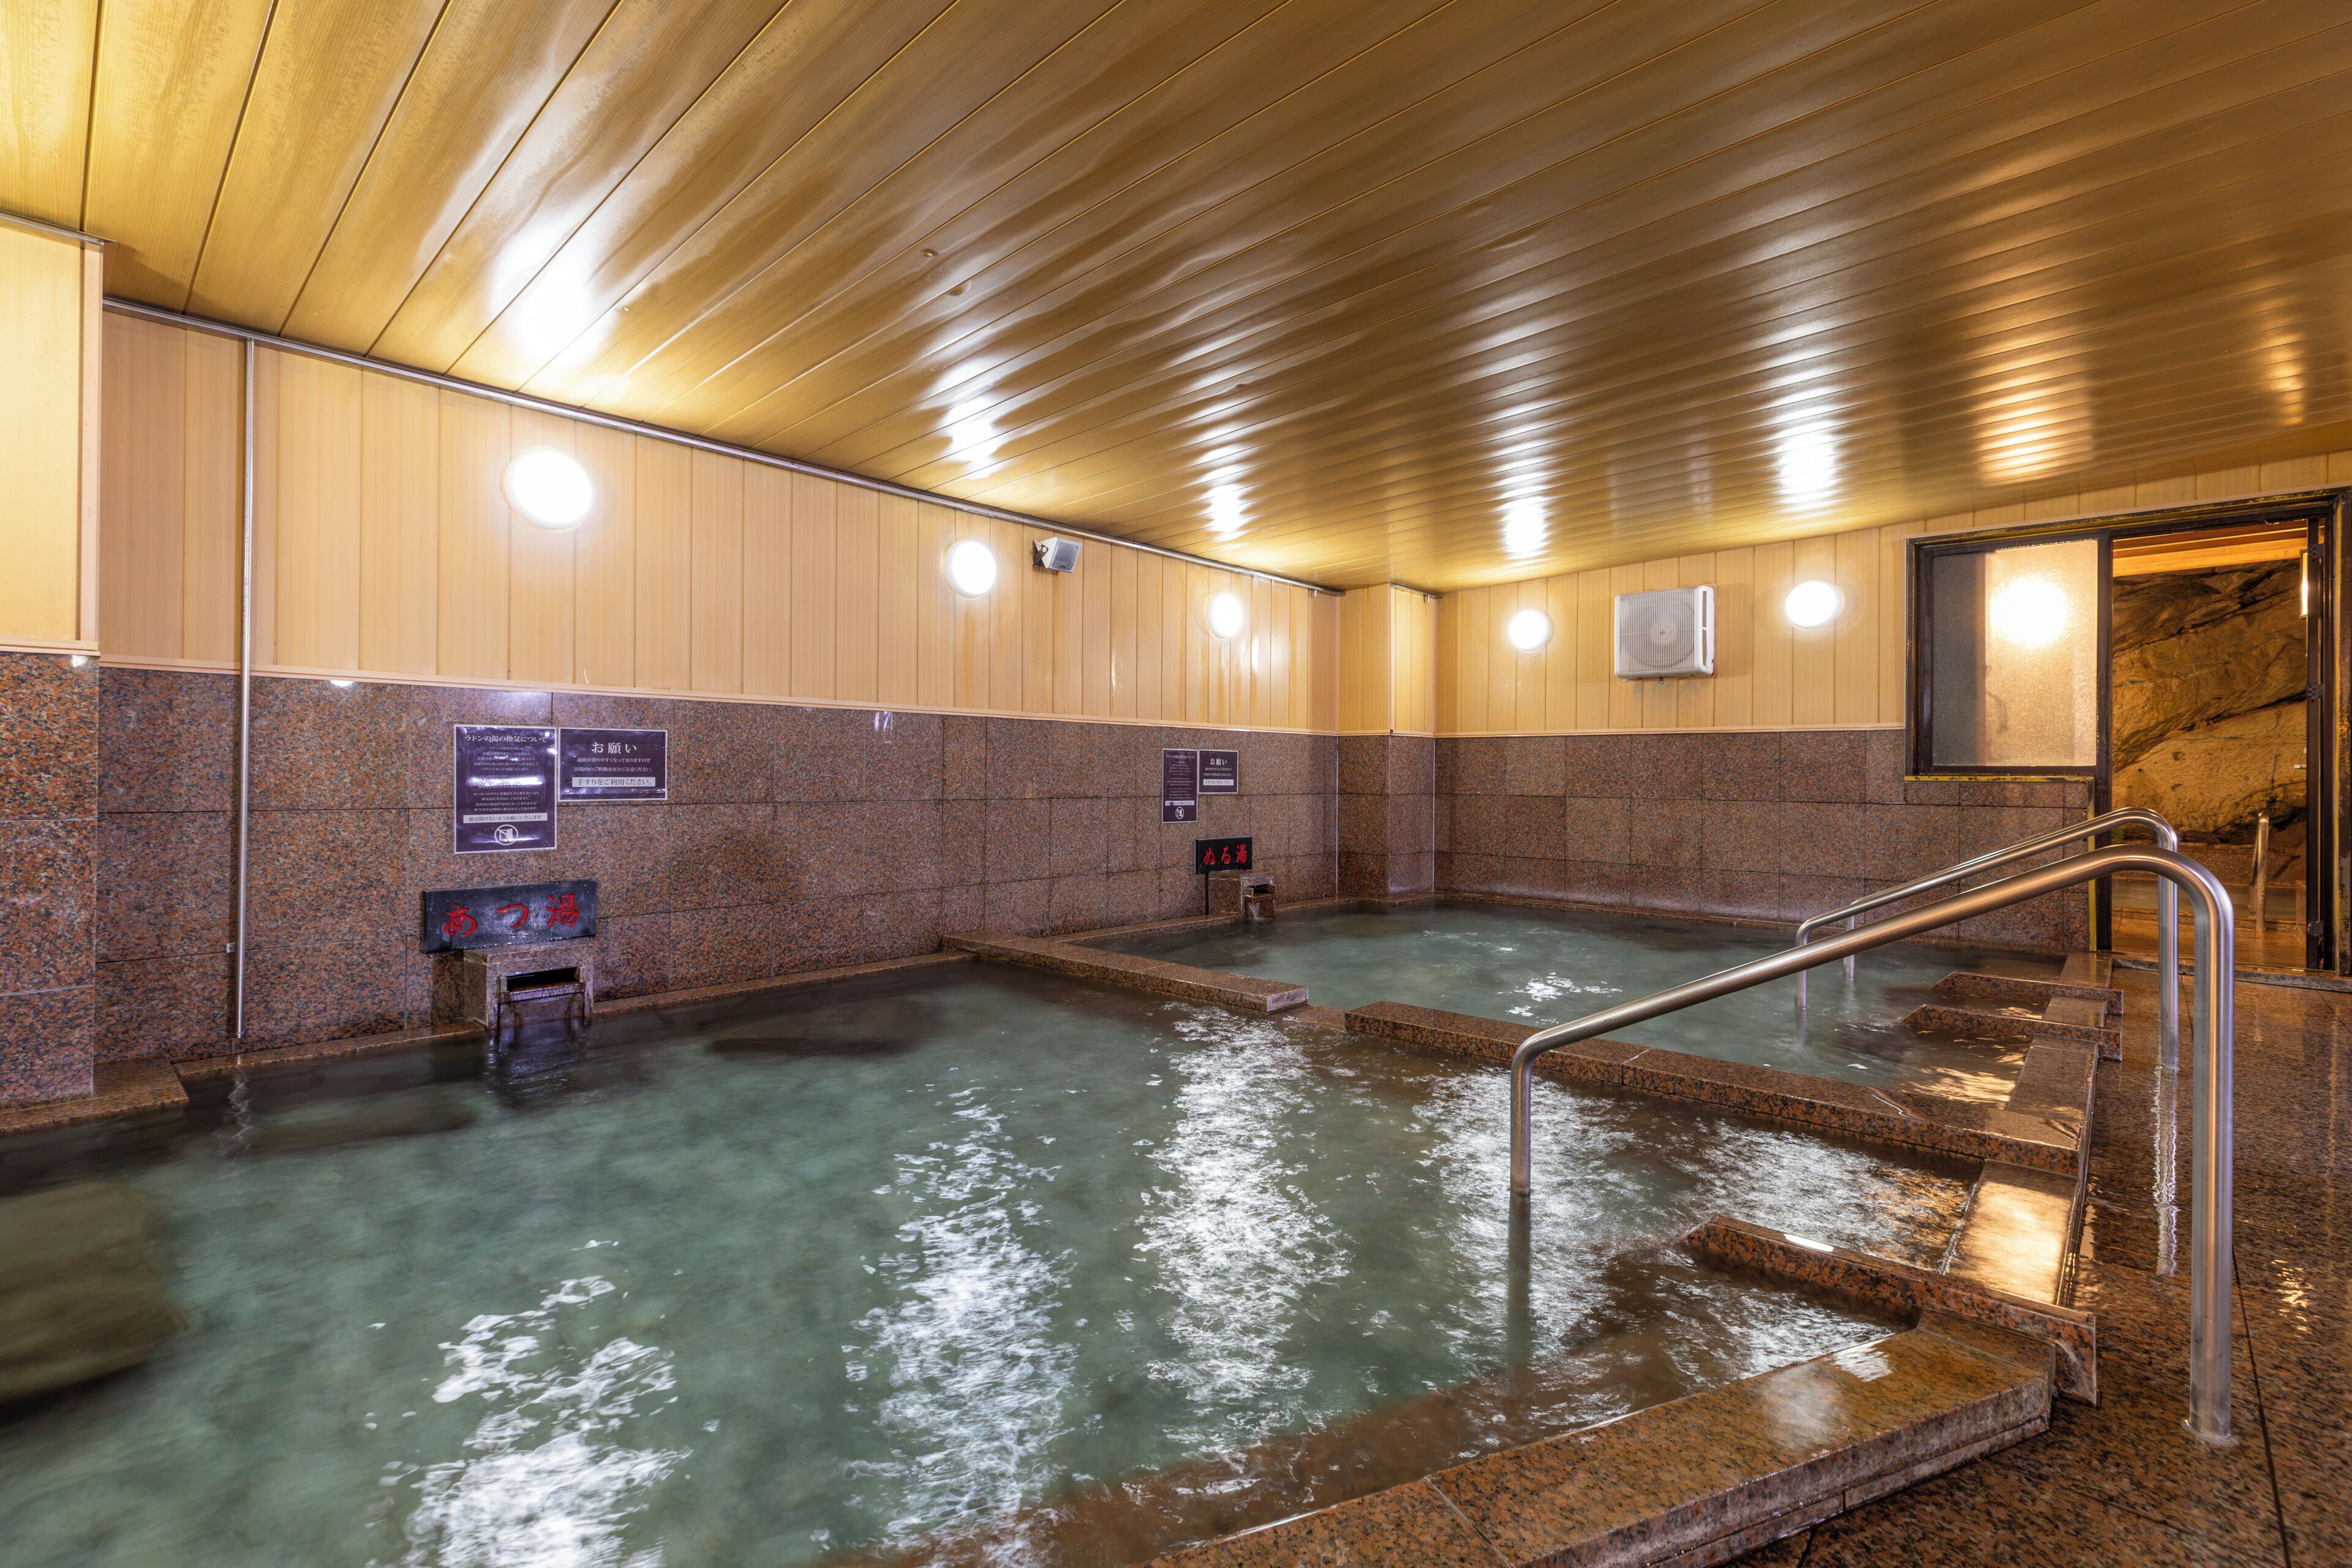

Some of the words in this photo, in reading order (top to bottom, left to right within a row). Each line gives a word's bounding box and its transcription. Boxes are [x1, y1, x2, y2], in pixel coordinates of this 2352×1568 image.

[591, 742, 637, 754] お願い
[1203, 843, 1248, 865] ぬる湯
[443, 892, 581, 937] あつ湯
